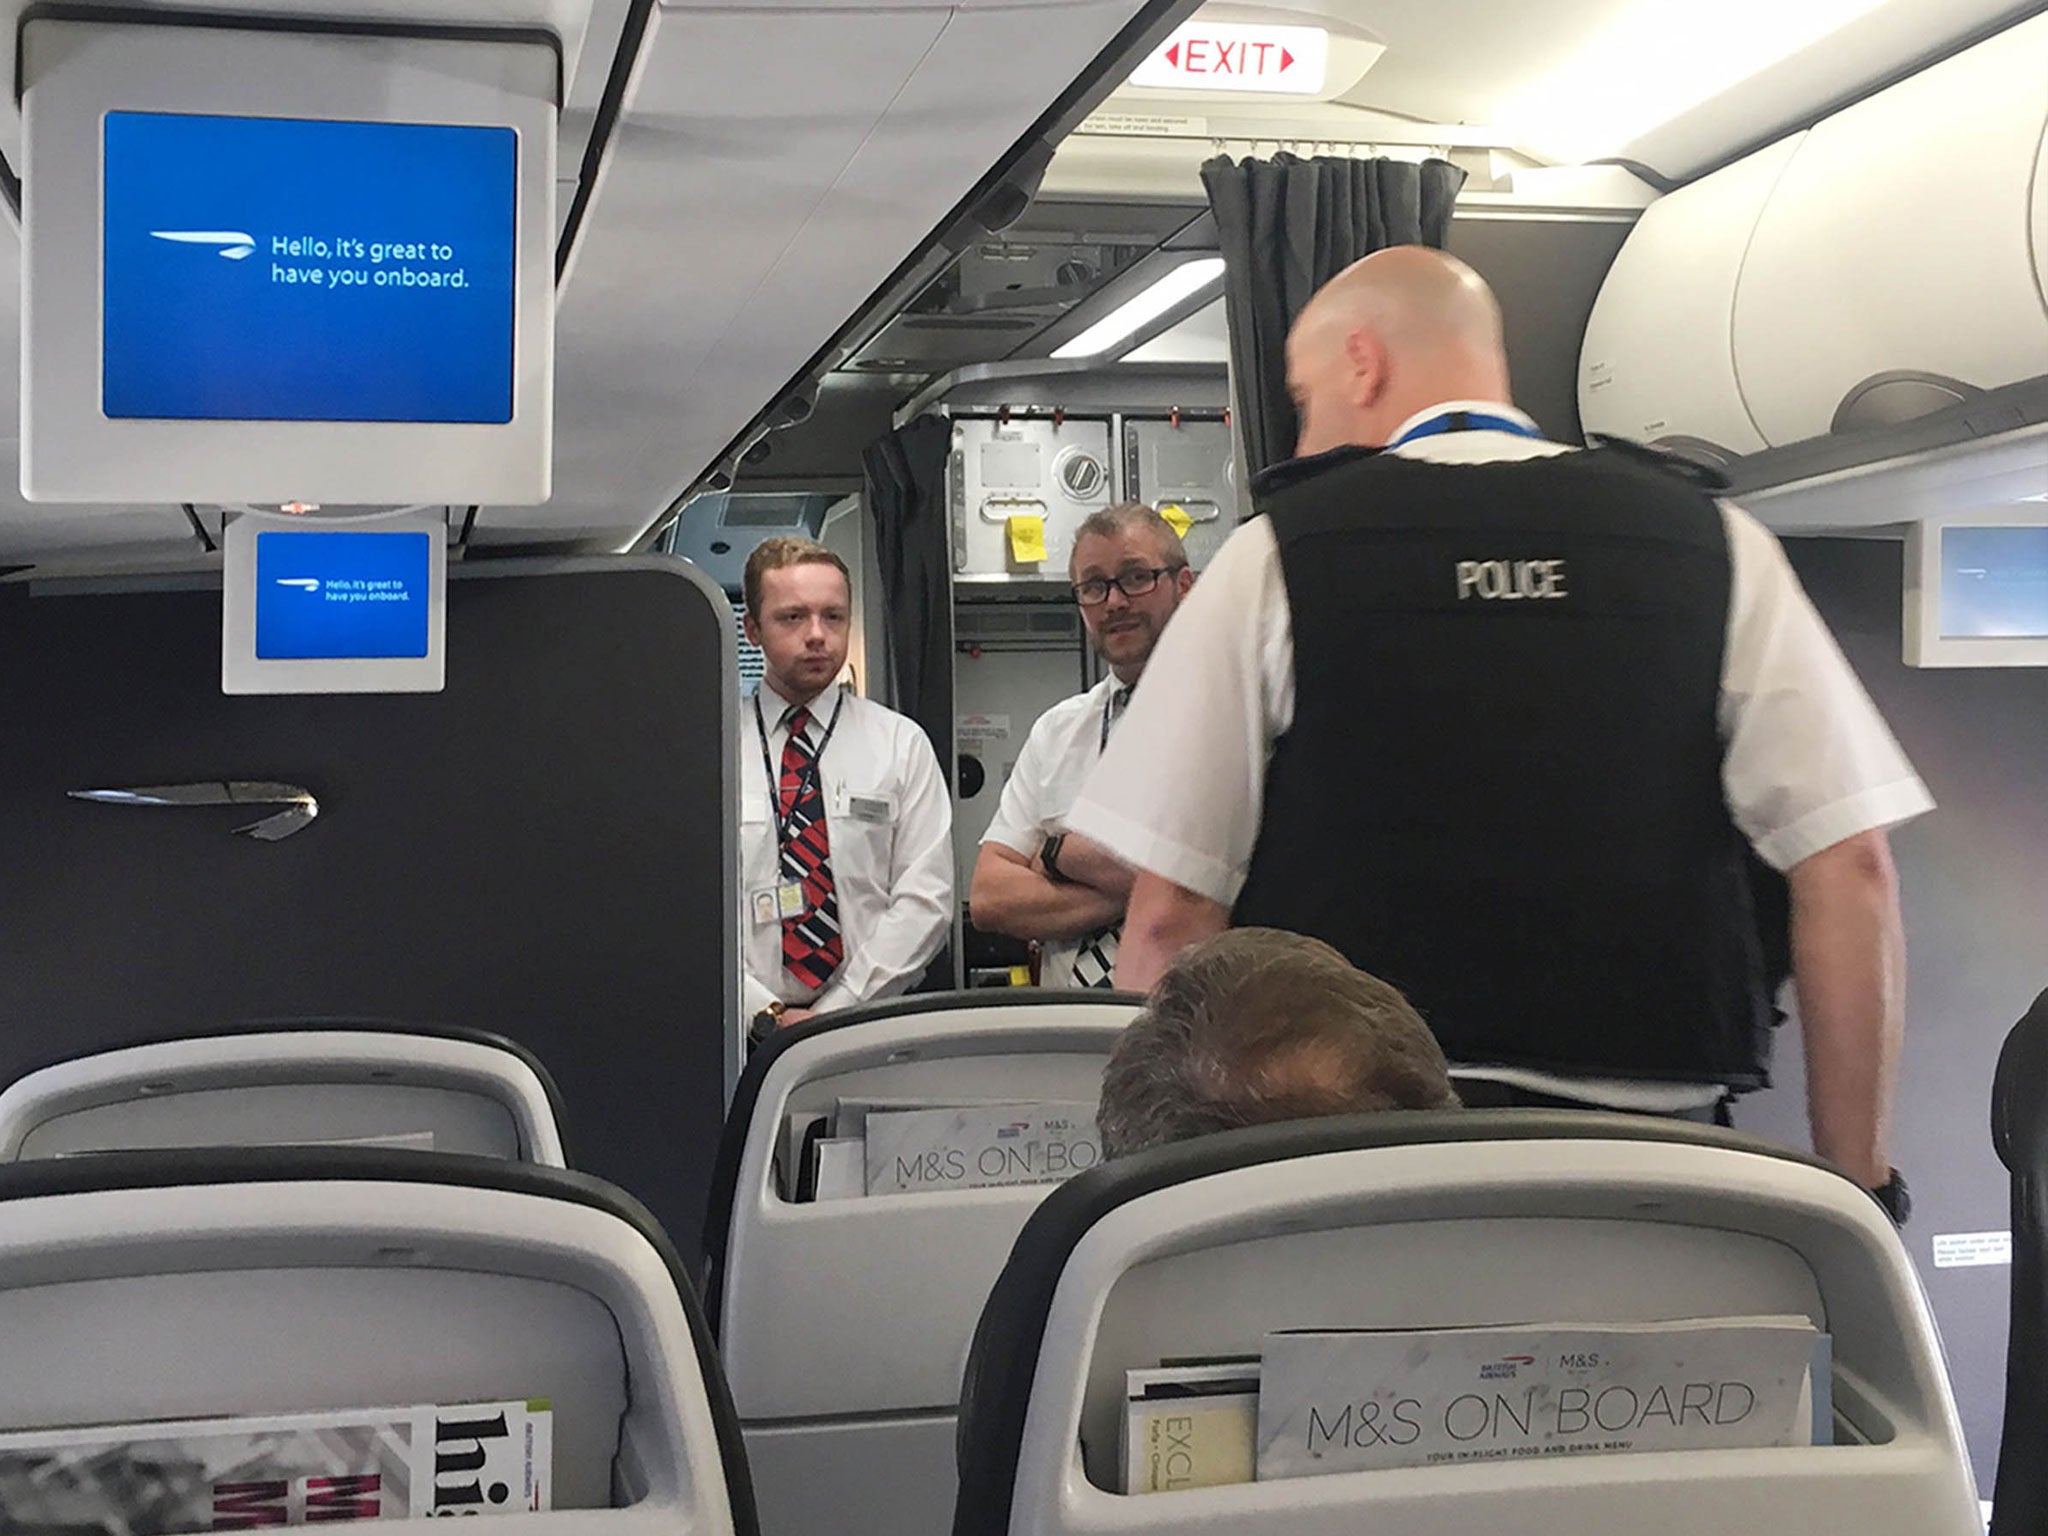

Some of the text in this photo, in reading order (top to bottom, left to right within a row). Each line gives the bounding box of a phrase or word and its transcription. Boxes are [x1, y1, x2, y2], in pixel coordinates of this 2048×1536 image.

[1185, 39, 1275, 75] EXIT
[271, 236, 453, 263] Hello, it's great to
[271, 263, 470, 289] have you onboard.
[367, 580, 391, 592] great
[392, 580, 403, 590] to
[1455, 560, 1569, 599] POLICE
[325, 591, 348, 601] have
[349, 592, 367, 604] you
[895, 1140, 1097, 1184] M&S ON BO
[1559, 1352, 1600, 1369] M&S
[1307, 1382, 1756, 1450] M&S ON BOARD
[1426, 1451, 1454, 1462] YOUR
[1511, 1445, 1540, 1456] FOOD
[1544, 1444, 1566, 1454] AND
[1603, 1440, 1633, 1450] MENU
